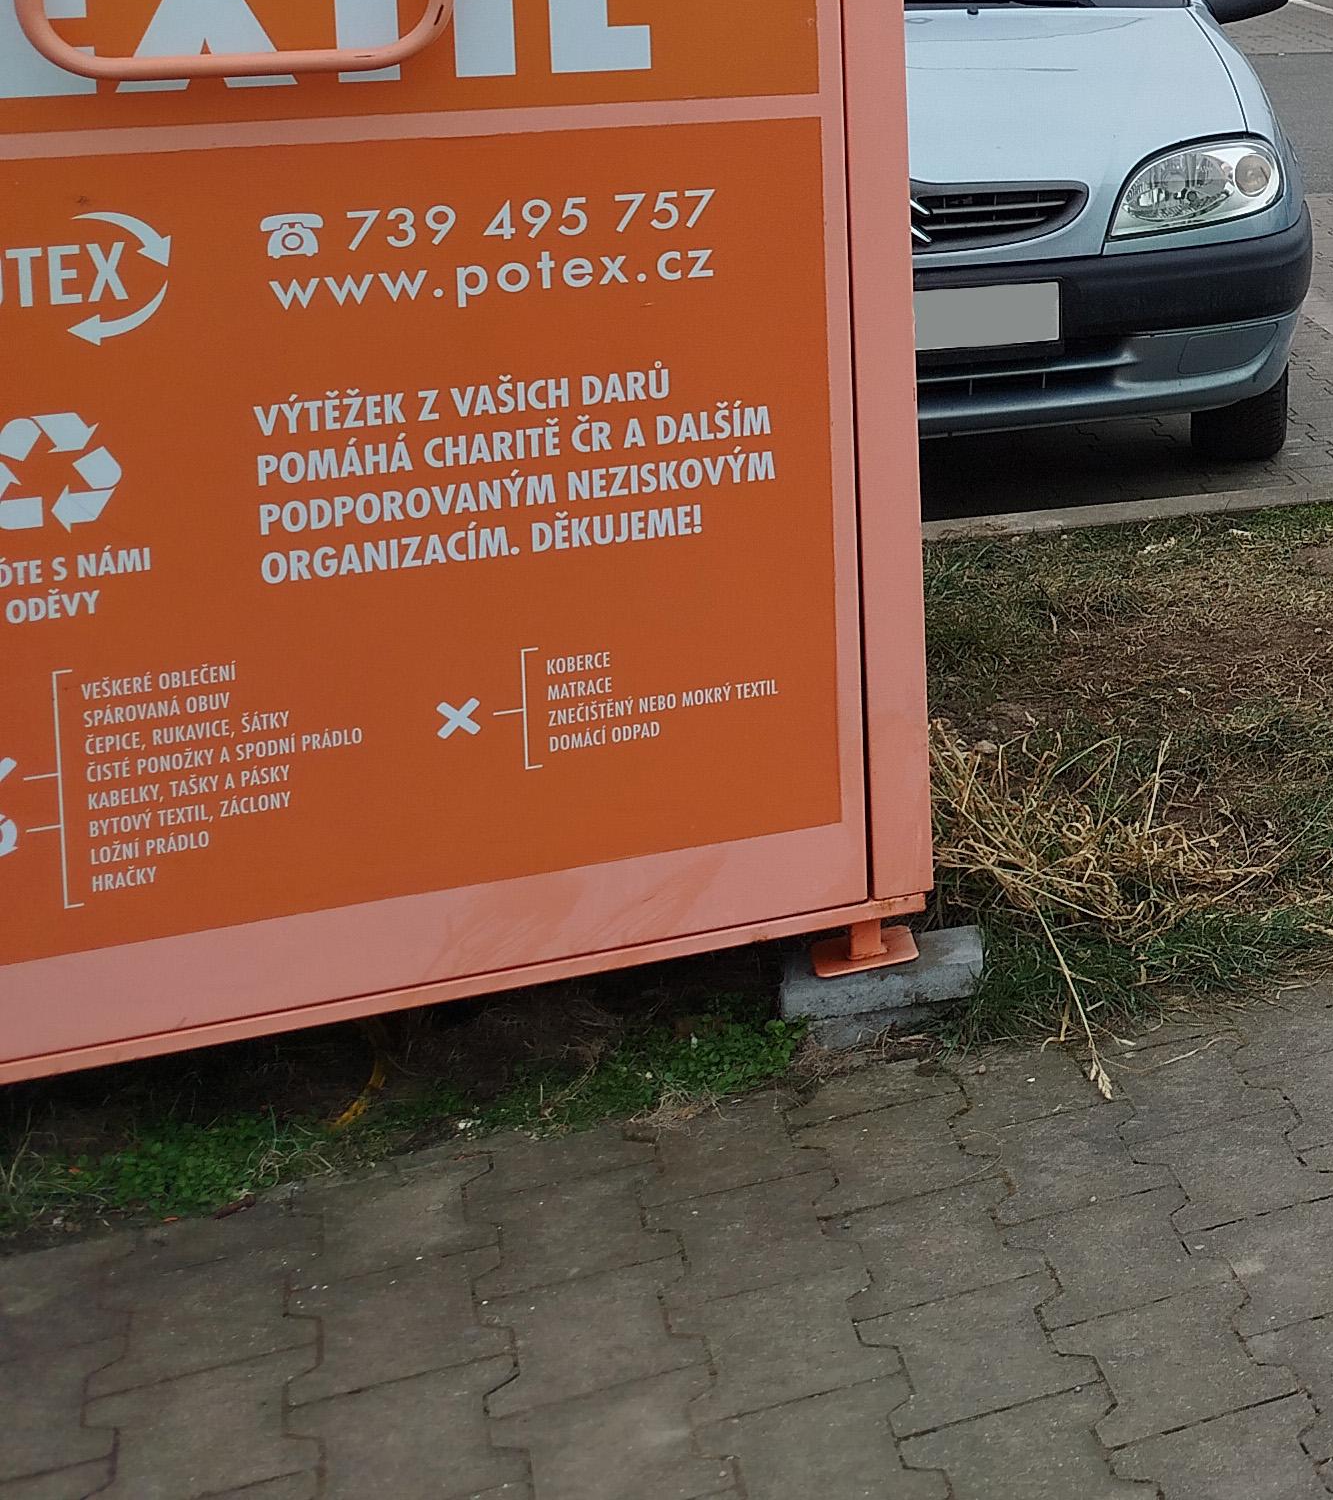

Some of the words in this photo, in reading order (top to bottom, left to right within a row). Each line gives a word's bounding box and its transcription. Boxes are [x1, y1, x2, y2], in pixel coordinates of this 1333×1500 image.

[347, 204, 456, 251] 739
[484, 196, 588, 240] 495
[615, 188, 716, 233] 757
[0, 241, 129, 308] TEX
[269, 249, 714, 310] www.potex.cz
[254, 389, 406, 437] VÝTĚŽEK
[418, 390, 440, 421] Z
[450, 374, 570, 421] VAŠICH
[582, 360, 670, 405] DARŮ
[257, 433, 414, 486] POMÁHÁ
[424, 418, 561, 469] CHARITĚ
[572, 414, 612, 453] ČR
[624, 418, 646, 448] A
[657, 400, 771, 445] DALŠÍM
[260, 469, 556, 536] PODPOROVANÝM
[568, 445, 775, 501] NEZISKOVÝM
[51, 556, 67, 581] S
[78, 545, 151, 578] NÁMI
[262, 521, 520, 584] ORGANIZACÍM.
[532, 504, 702, 553] DĚKUJEME!
[6, 588, 100, 624] ODĚVY
[82, 671, 153, 700] VEŠKERÉ
[159, 660, 236, 690] OBLEČENÍ
[547, 651, 611, 676] KOBERCE
[84, 695, 181, 728] SPÁROVANÁ
[186, 691, 230, 714] OBUV
[548, 676, 613, 701] MATRACE
[549, 698, 634, 727] ZNEČIŠTĚNÝ
[640, 693, 677, 714] NEBO
[683, 682, 732, 708] MOKRÝ
[736, 679, 779, 699] TEXTIL
[86, 731, 146, 755] ČEPICE,
[153, 719, 235, 746] RUKAVICE,
[242, 710, 289, 733] ŠÁTKY
[87, 756, 131, 783] ČISTÉ
[138, 747, 214, 775] PONOŽKY
[220, 746, 231, 764] A
[236, 732, 296, 761] SPODNÍ
[302, 727, 363, 752] PRÁDLO
[550, 724, 606, 752] DOMÁCÍ
[612, 721, 660, 743] ODPAD
[89, 783, 164, 810] KABELKY,
[170, 774, 219, 798] TAŠKY
[225, 772, 236, 790] A
[241, 764, 290, 788] PÁSKY
[90, 812, 152, 838] BYTOVÝ
[157, 803, 214, 827] TEXTIL,
[220, 791, 291, 818] ZÁCLONY
[91, 840, 139, 865] LOŽNÍ
[146, 830, 210, 856] PRÁDLO
[93, 865, 157, 893] HRAČKY
